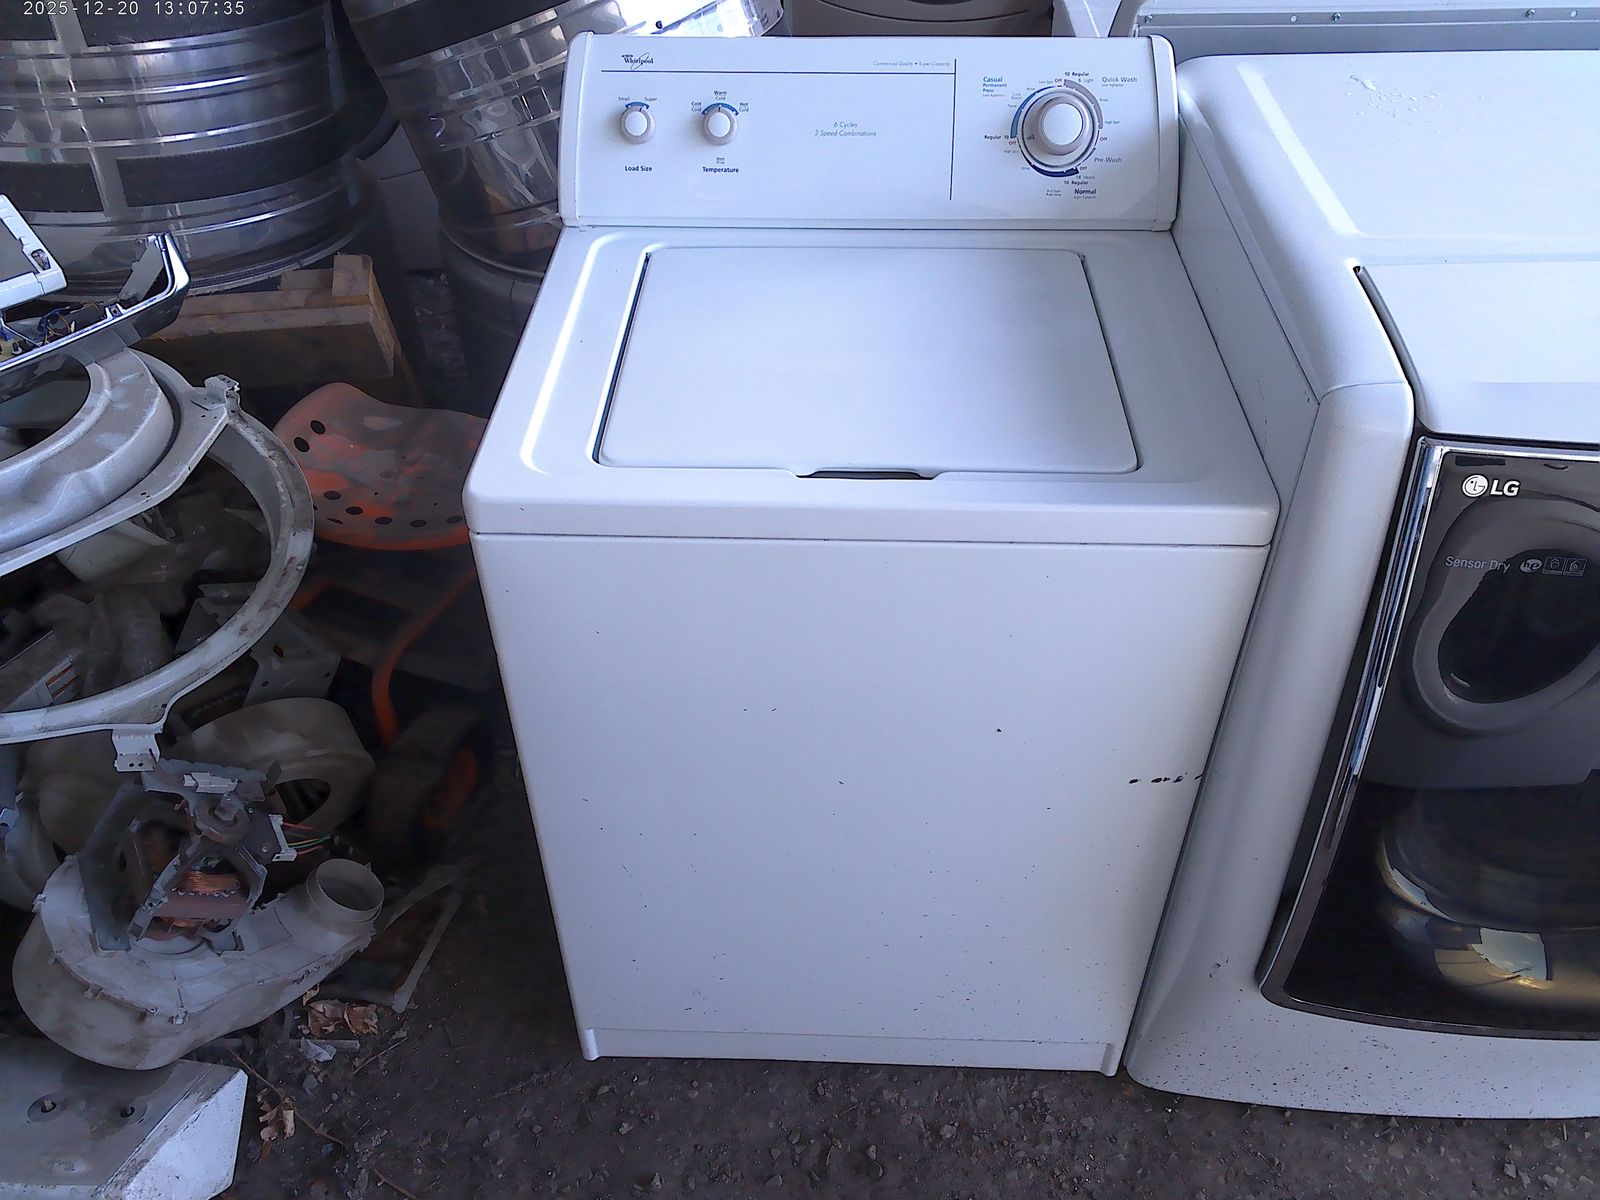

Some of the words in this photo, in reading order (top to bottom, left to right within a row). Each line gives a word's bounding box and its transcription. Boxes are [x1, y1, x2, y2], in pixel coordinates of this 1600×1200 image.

[622, 55, 654, 66] Whirlpool
[839, 121, 858, 130] Cycles
[814, 129, 819, 137] 3
[819, 129, 838, 138] Speed
[838, 129, 877, 137] Combinations
[702, 166, 740, 174] Temperature
[1490, 479, 1520, 496] LG
[1445, 555, 1487, 569] Sensor
[1488, 560, 1511, 574] Dry
